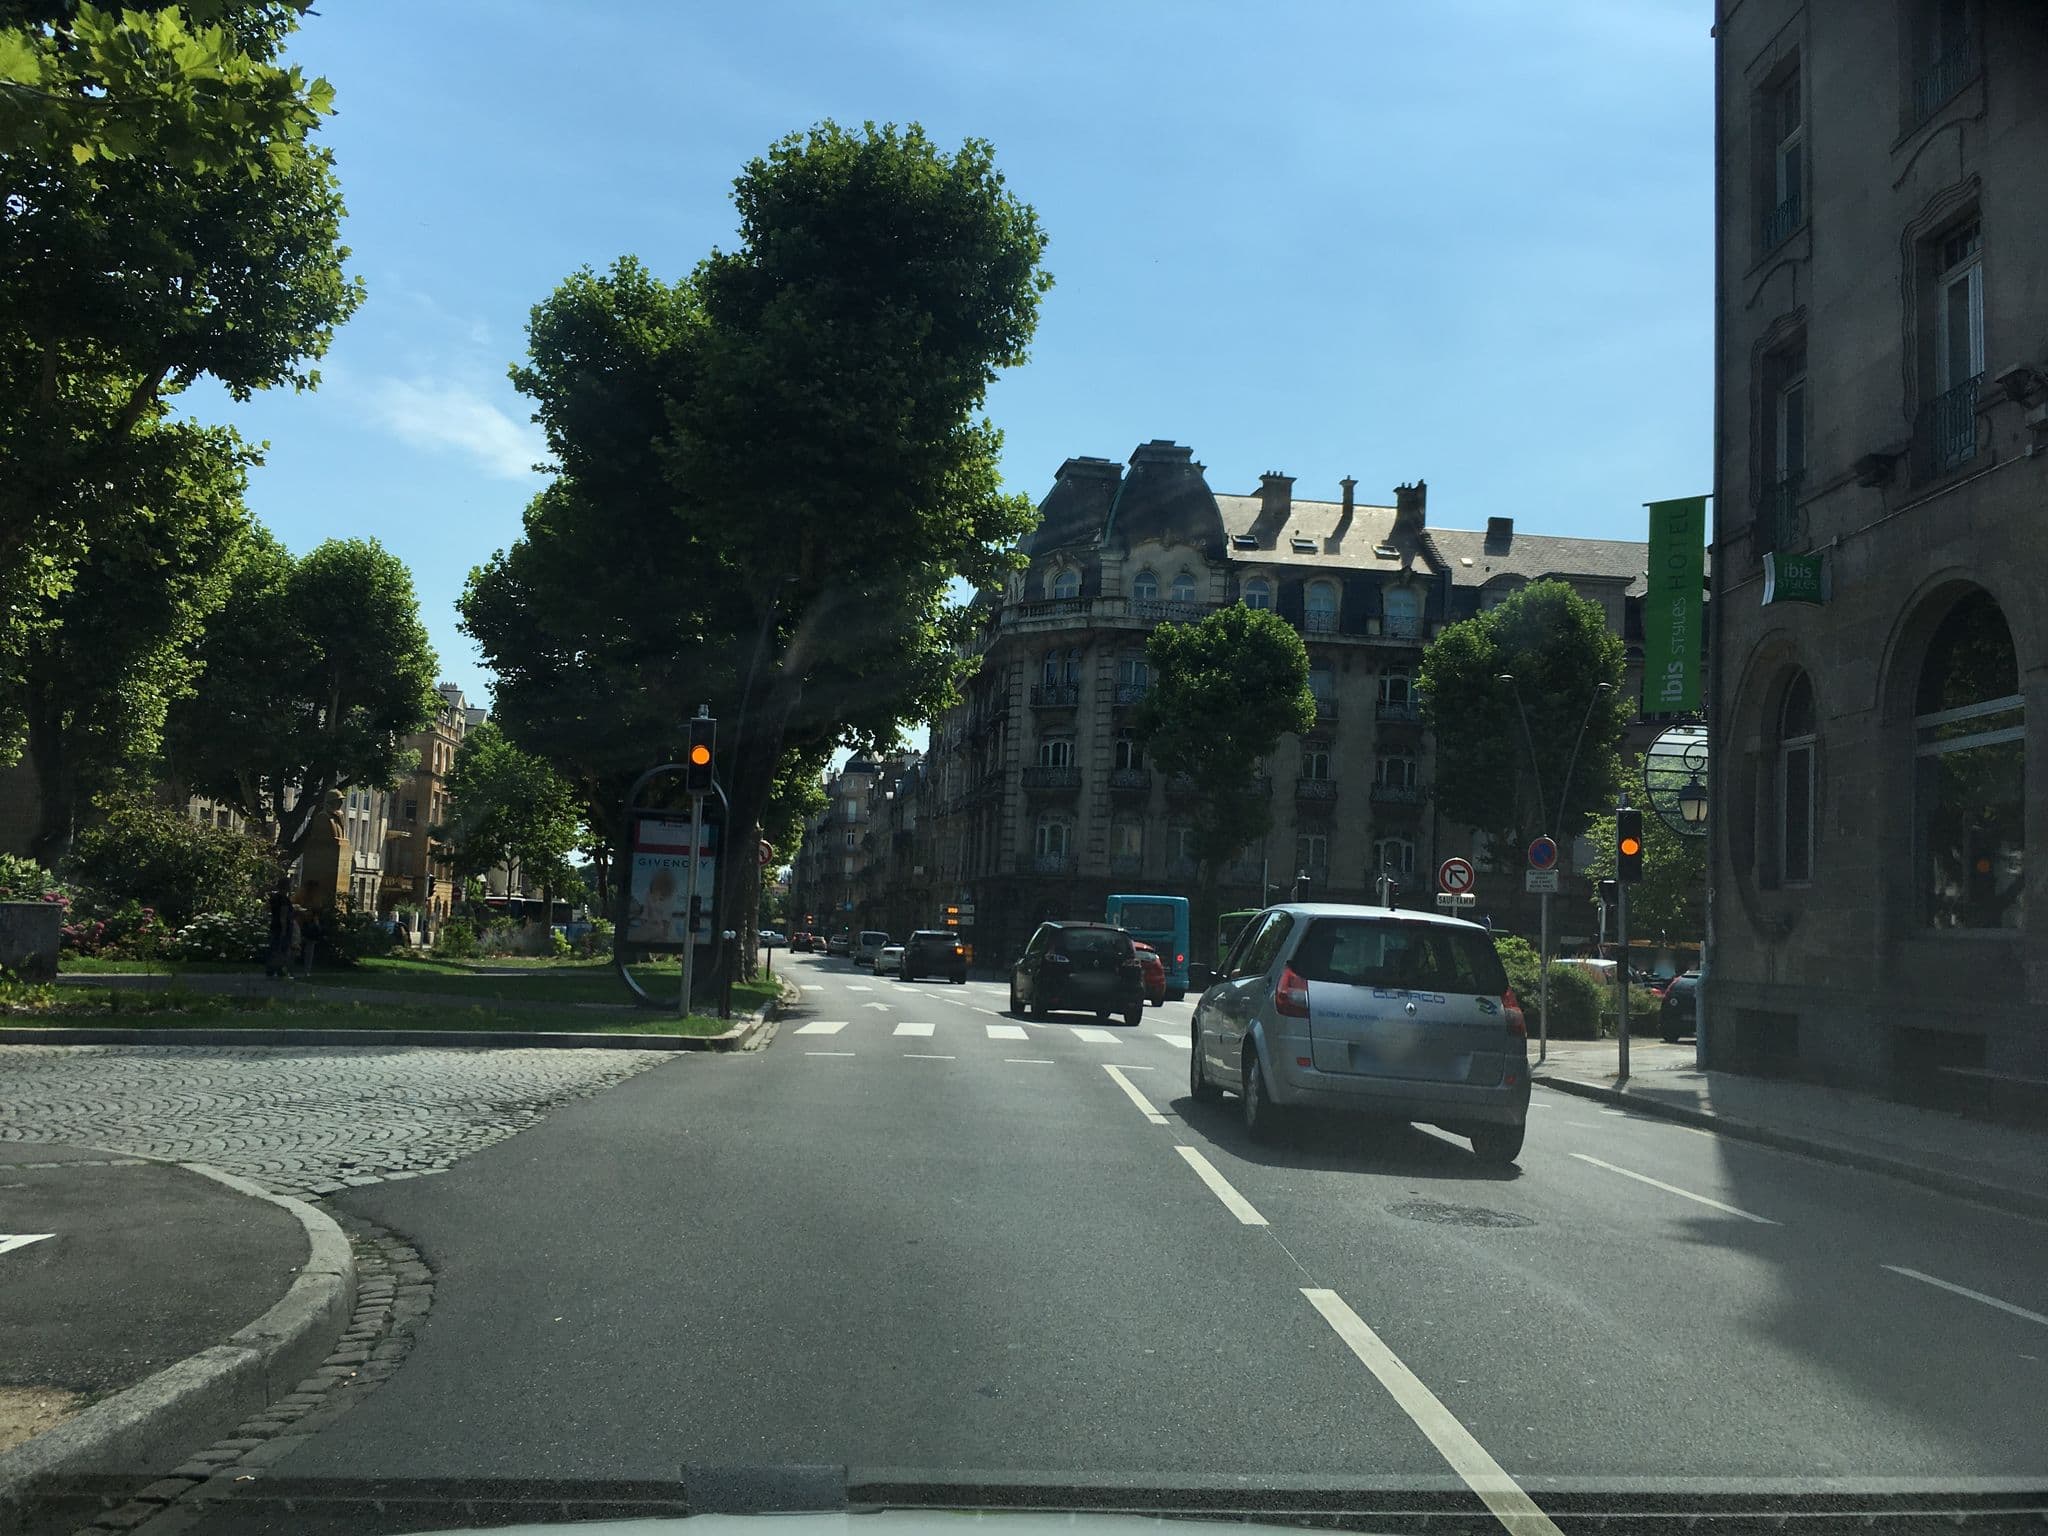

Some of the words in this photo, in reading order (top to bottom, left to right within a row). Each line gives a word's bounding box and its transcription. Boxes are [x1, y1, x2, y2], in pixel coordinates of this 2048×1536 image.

[1666, 507, 1689, 590] HOTEL
[1783, 562, 1812, 578] ibis
[1661, 662, 1684, 702] ibis
[638, 857, 708, 868] GIVENCY
[1438, 895, 1454, 905] SAUF
